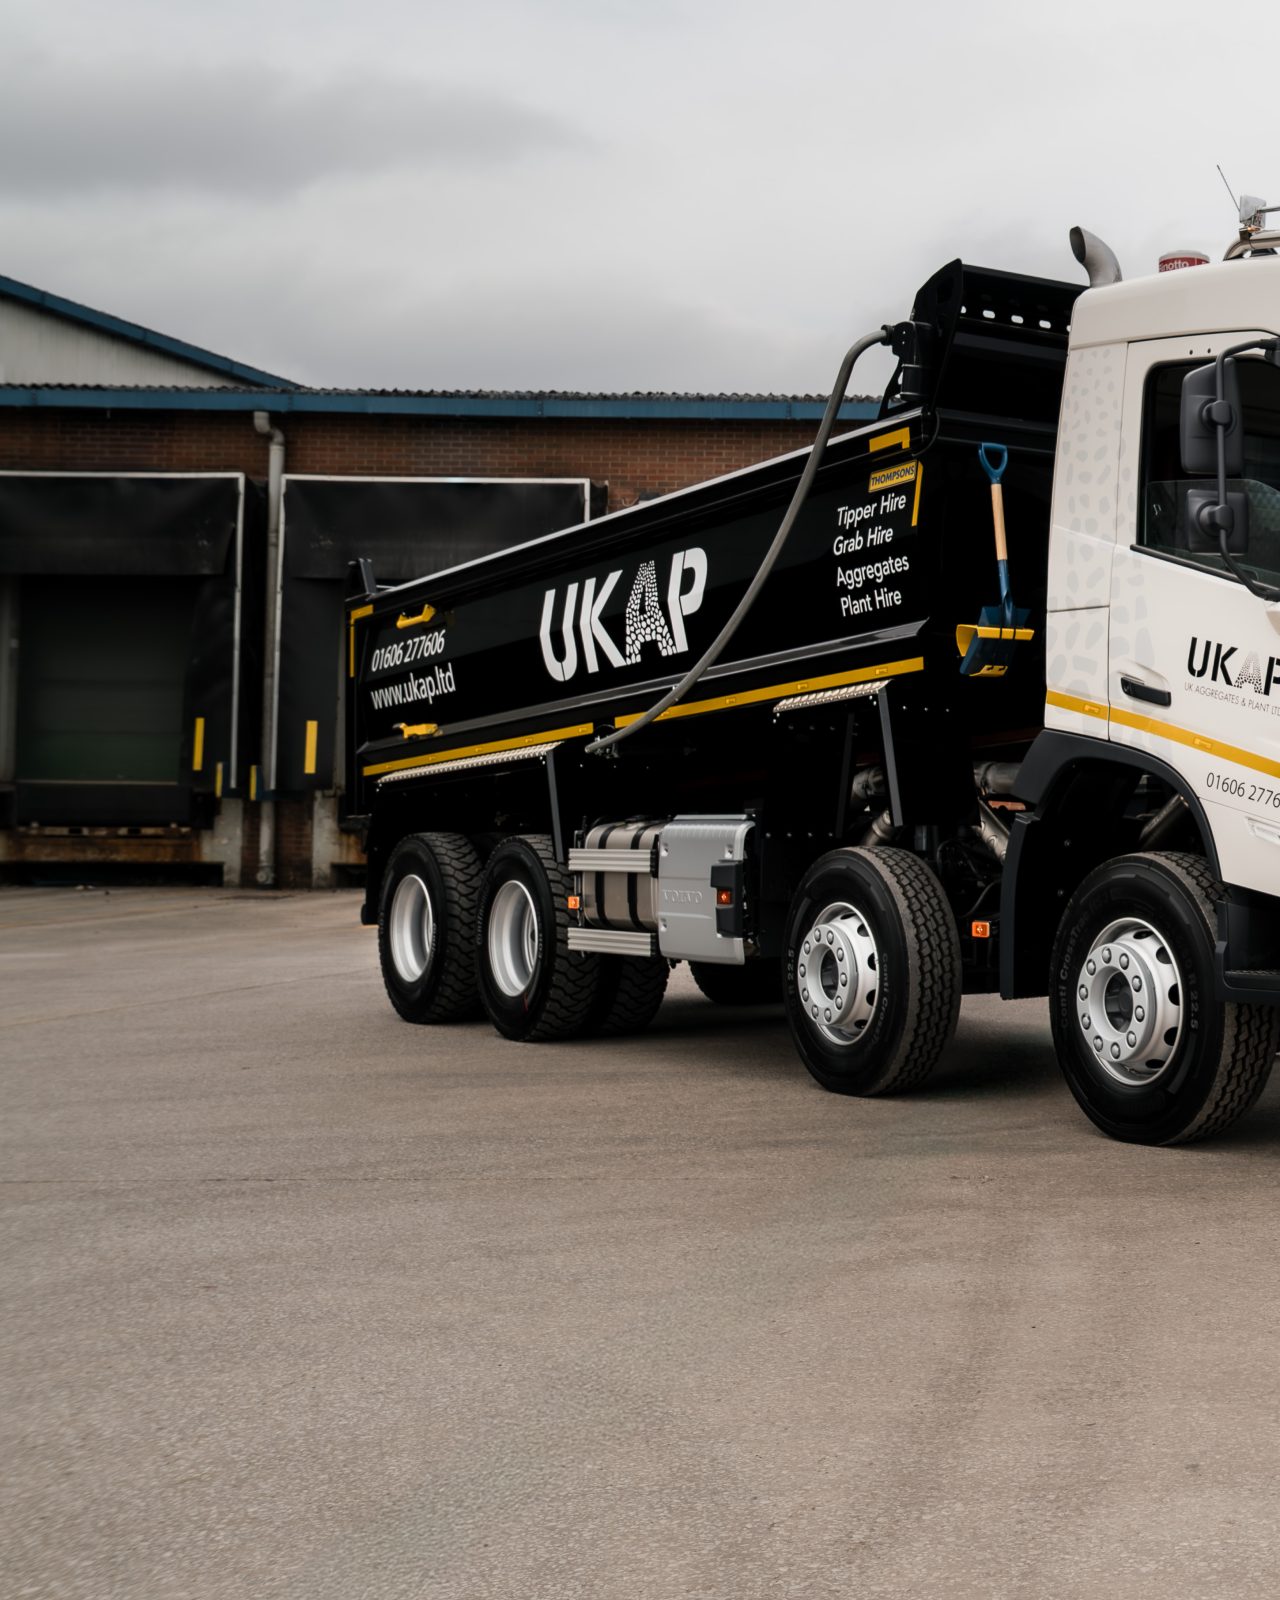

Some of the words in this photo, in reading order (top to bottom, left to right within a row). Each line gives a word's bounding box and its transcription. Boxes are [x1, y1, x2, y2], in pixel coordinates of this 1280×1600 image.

[871, 465, 915, 487] THOMPSONS
[837, 505, 877, 529] Tipper
[880, 492, 906, 515] Hire
[833, 530, 863, 556] Grab
[866, 525, 893, 548] Hire
[837, 555, 910, 590] Aggregates
[539, 547, 708, 682] UKAP
[840, 594, 873, 617] Plant
[874, 587, 902, 610] Hire
[371, 641, 404, 672] 01606
[404, 629, 446, 663] 277606
[370, 661, 456, 710] www.ukap.ltd
[1184, 682, 1194, 692] UK
[1195, 685, 1240, 705] AGGREGATES
[1240, 697, 1246, 707] &
[1248, 699, 1270, 713] PLANT
[1206, 772, 1245, 798] 01606
[661, 888, 703, 904] VOLVO
[1058, 984, 1070, 1030] Conti
[1189, 987, 1199, 1032] 22.5
